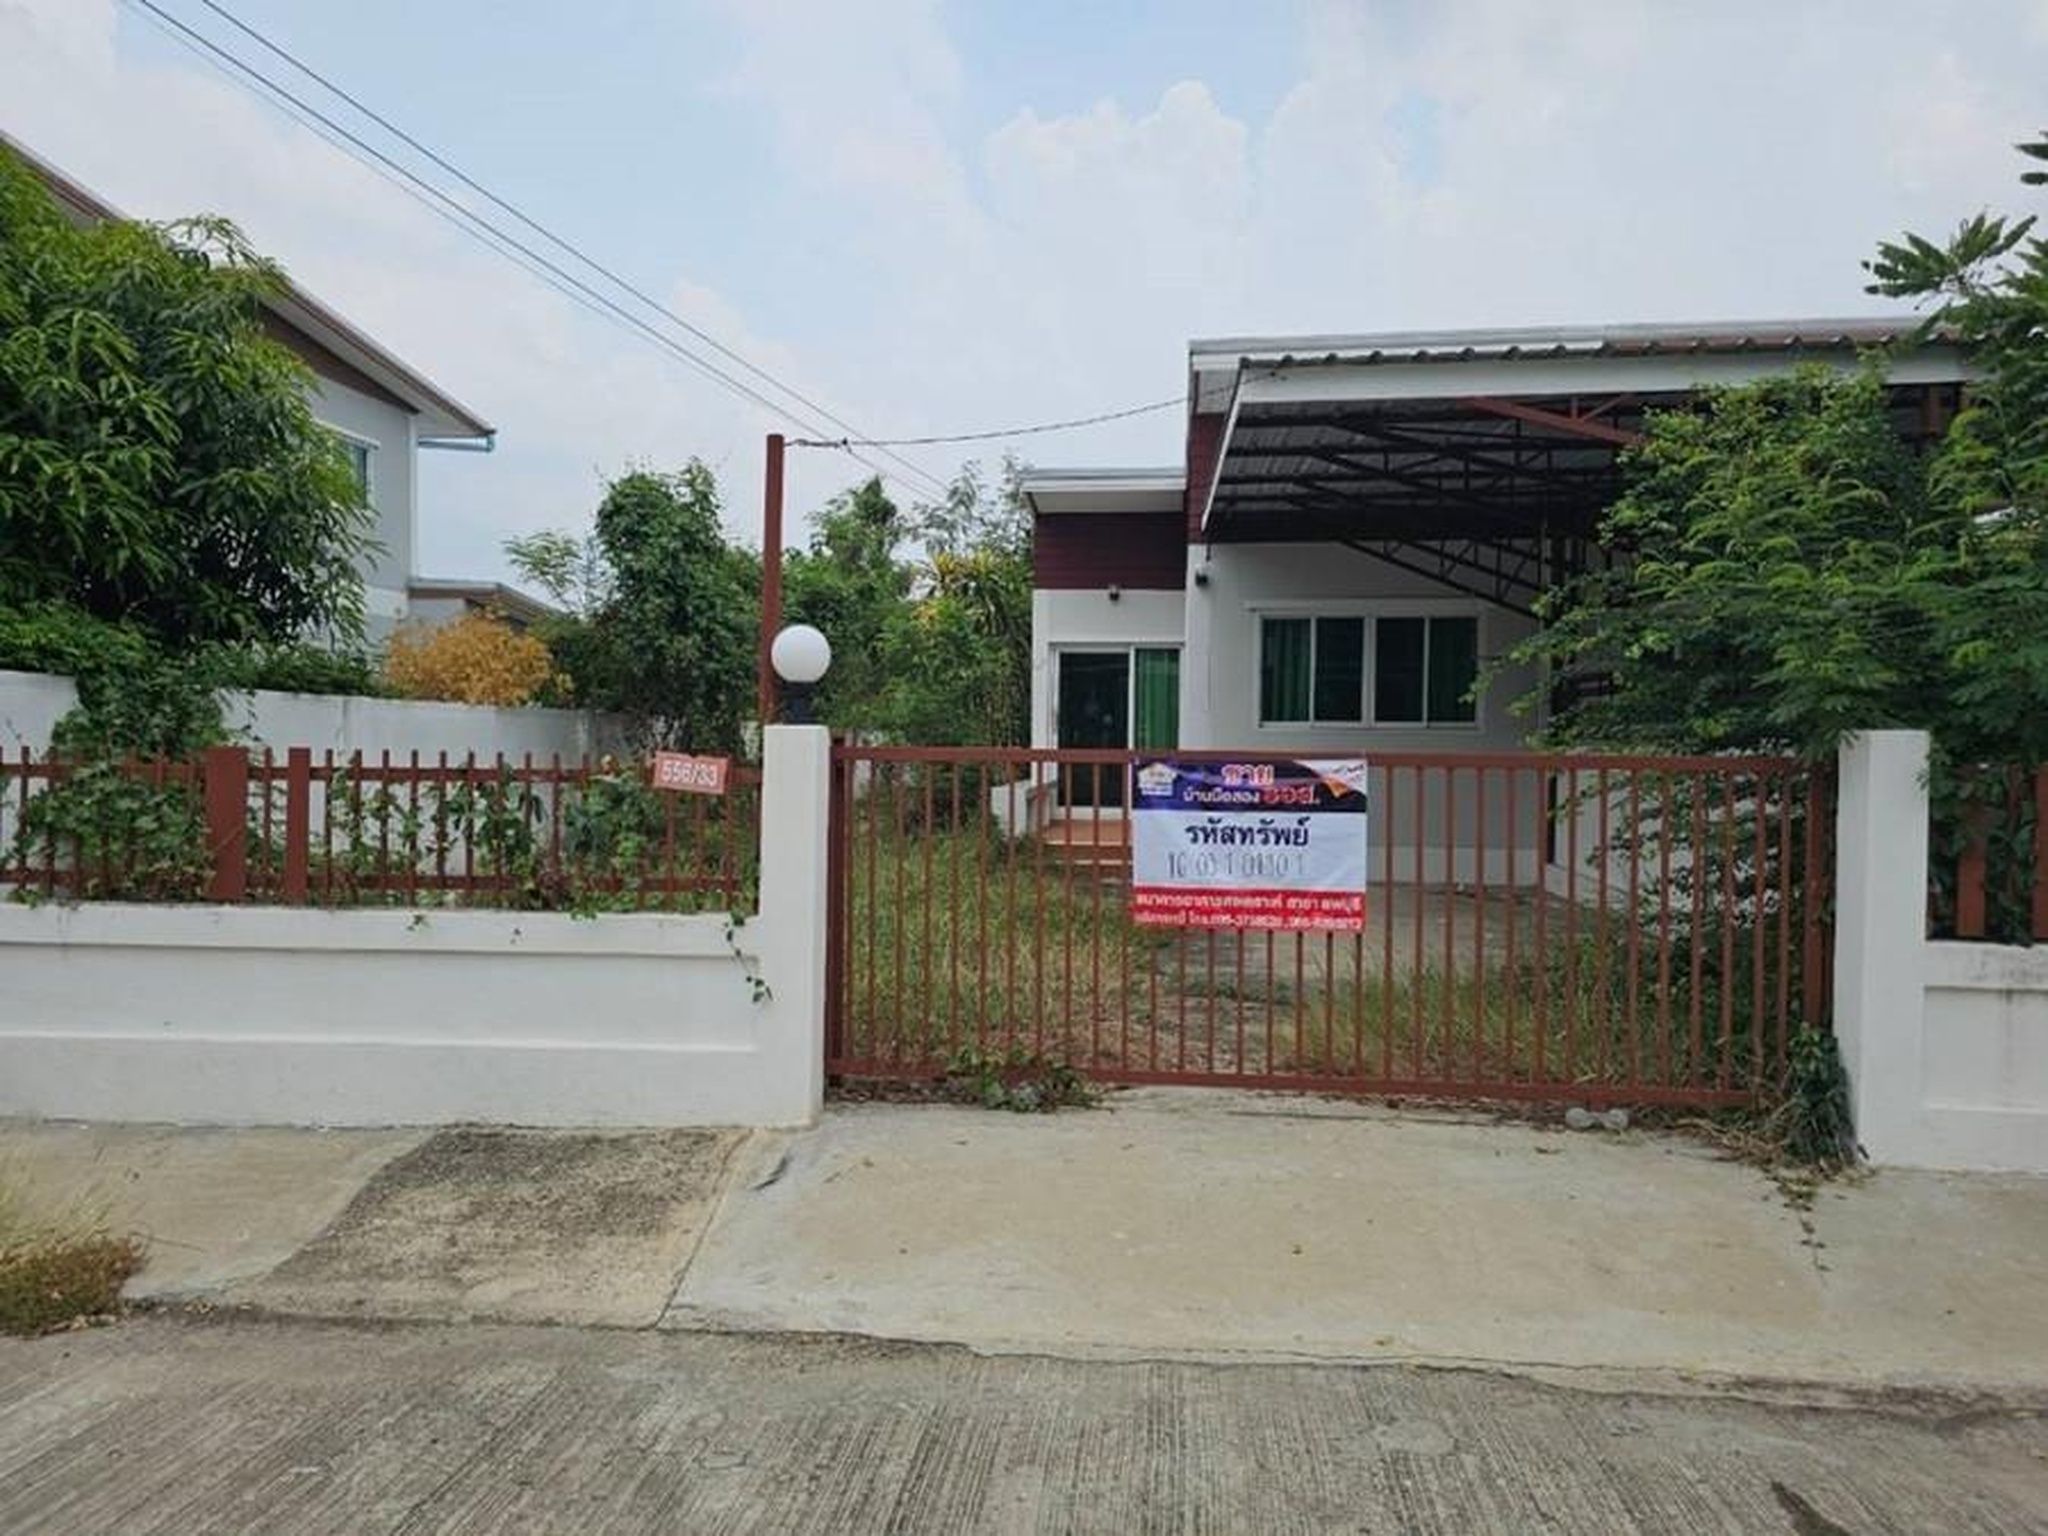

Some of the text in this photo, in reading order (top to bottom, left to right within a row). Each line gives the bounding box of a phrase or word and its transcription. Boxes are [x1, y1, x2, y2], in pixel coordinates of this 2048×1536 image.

[1221, 764, 1275, 786] ขาย
[1183, 786, 1260, 804] บ้านมือสอง
[1185, 816, 1311, 847] รหัสทรัพย์
